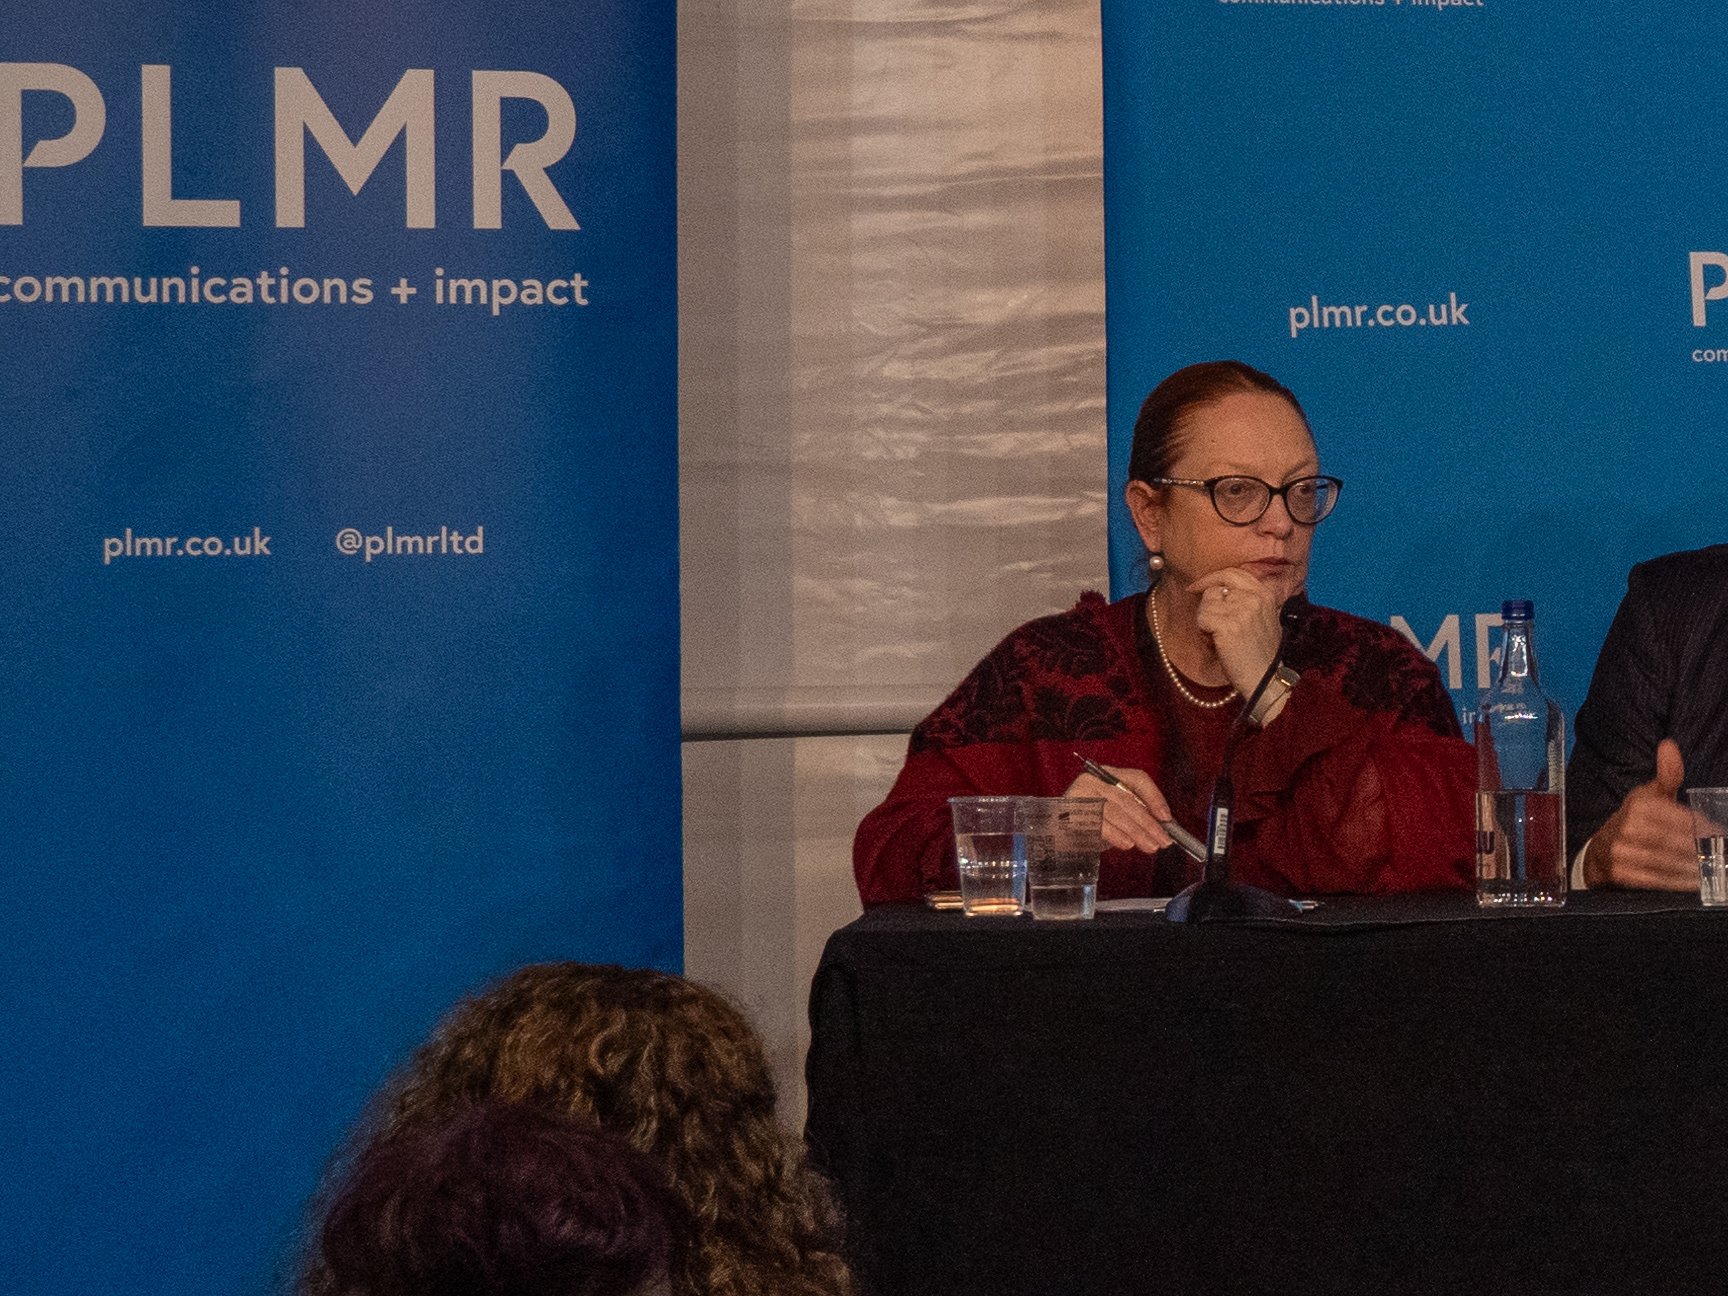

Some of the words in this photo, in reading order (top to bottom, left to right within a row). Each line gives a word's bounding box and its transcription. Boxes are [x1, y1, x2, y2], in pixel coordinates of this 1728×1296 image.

[0, 62, 581, 231] PLMR
[0, 266, 374, 306] communications
[390, 278, 417, 305] +
[434, 266, 589, 316] impact
[1289, 291, 1470, 338] plmr.co.uk
[103, 526, 271, 565] plmr.co.uk
[335, 525, 484, 563] @plmrltd
